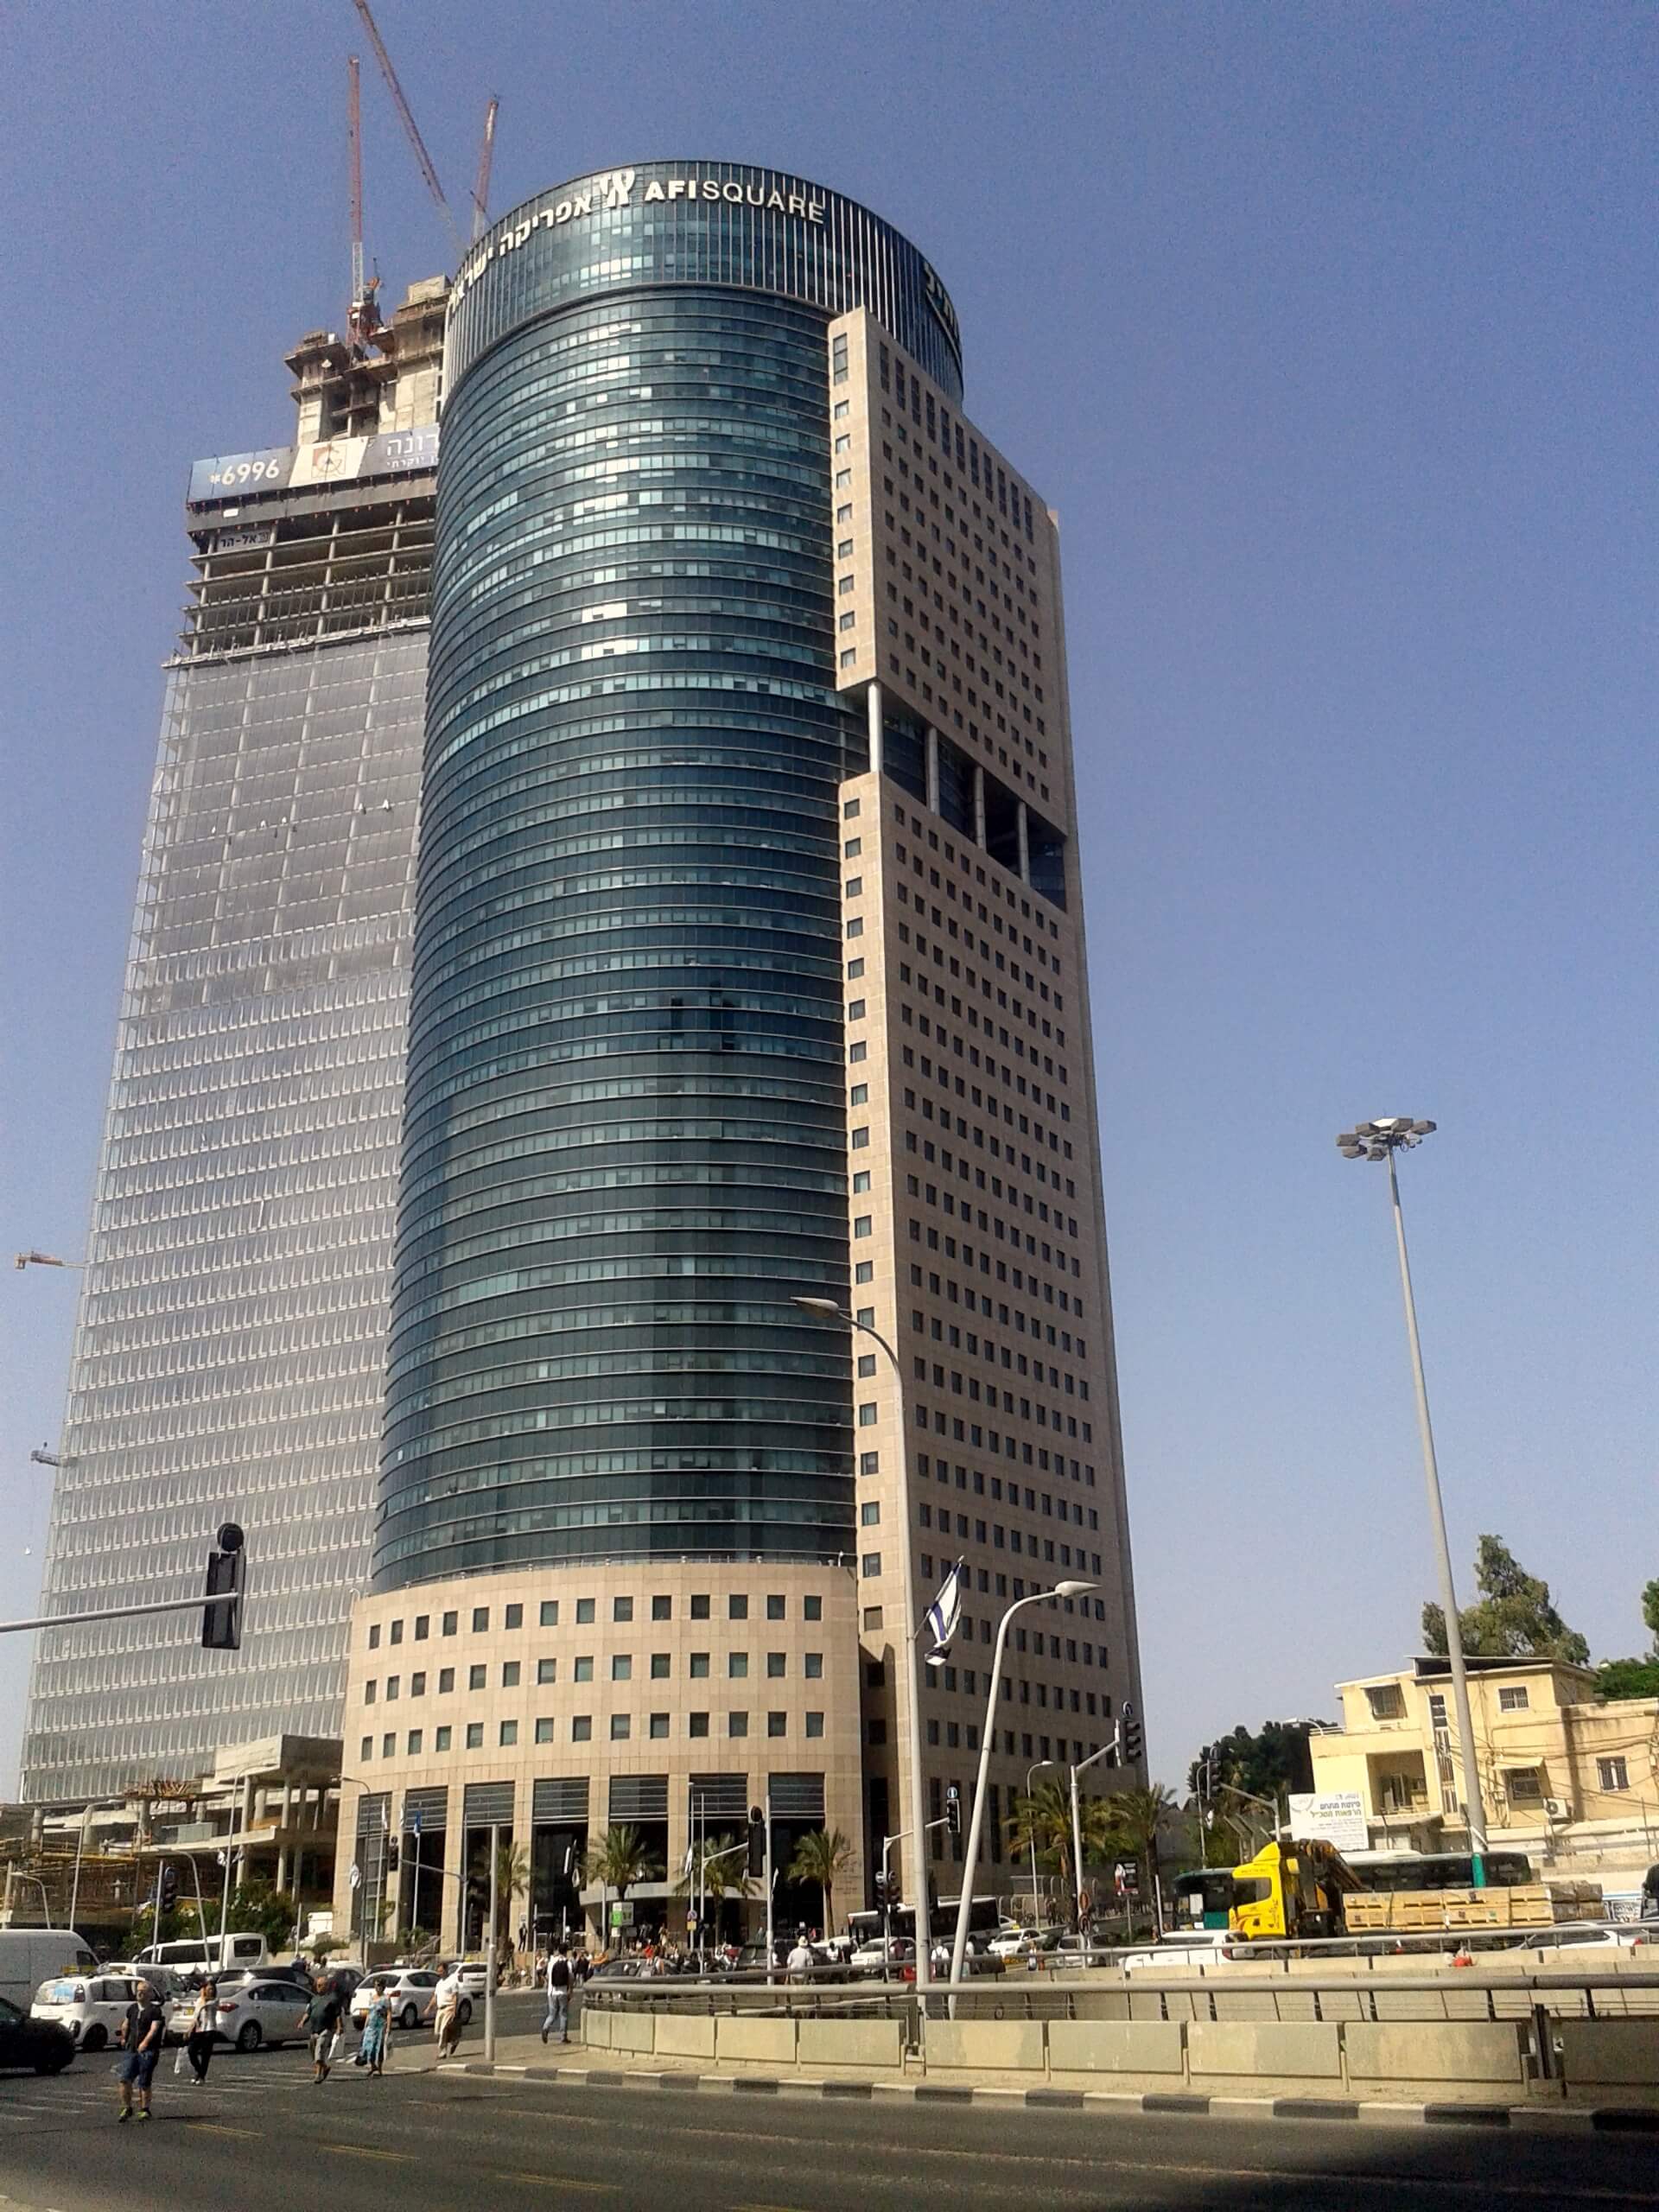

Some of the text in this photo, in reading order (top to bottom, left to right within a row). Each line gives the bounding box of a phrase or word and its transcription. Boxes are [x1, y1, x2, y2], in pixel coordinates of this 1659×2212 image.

[499, 194, 592, 257] אפריקה
[645, 180, 824, 225] AFI SQUARE
